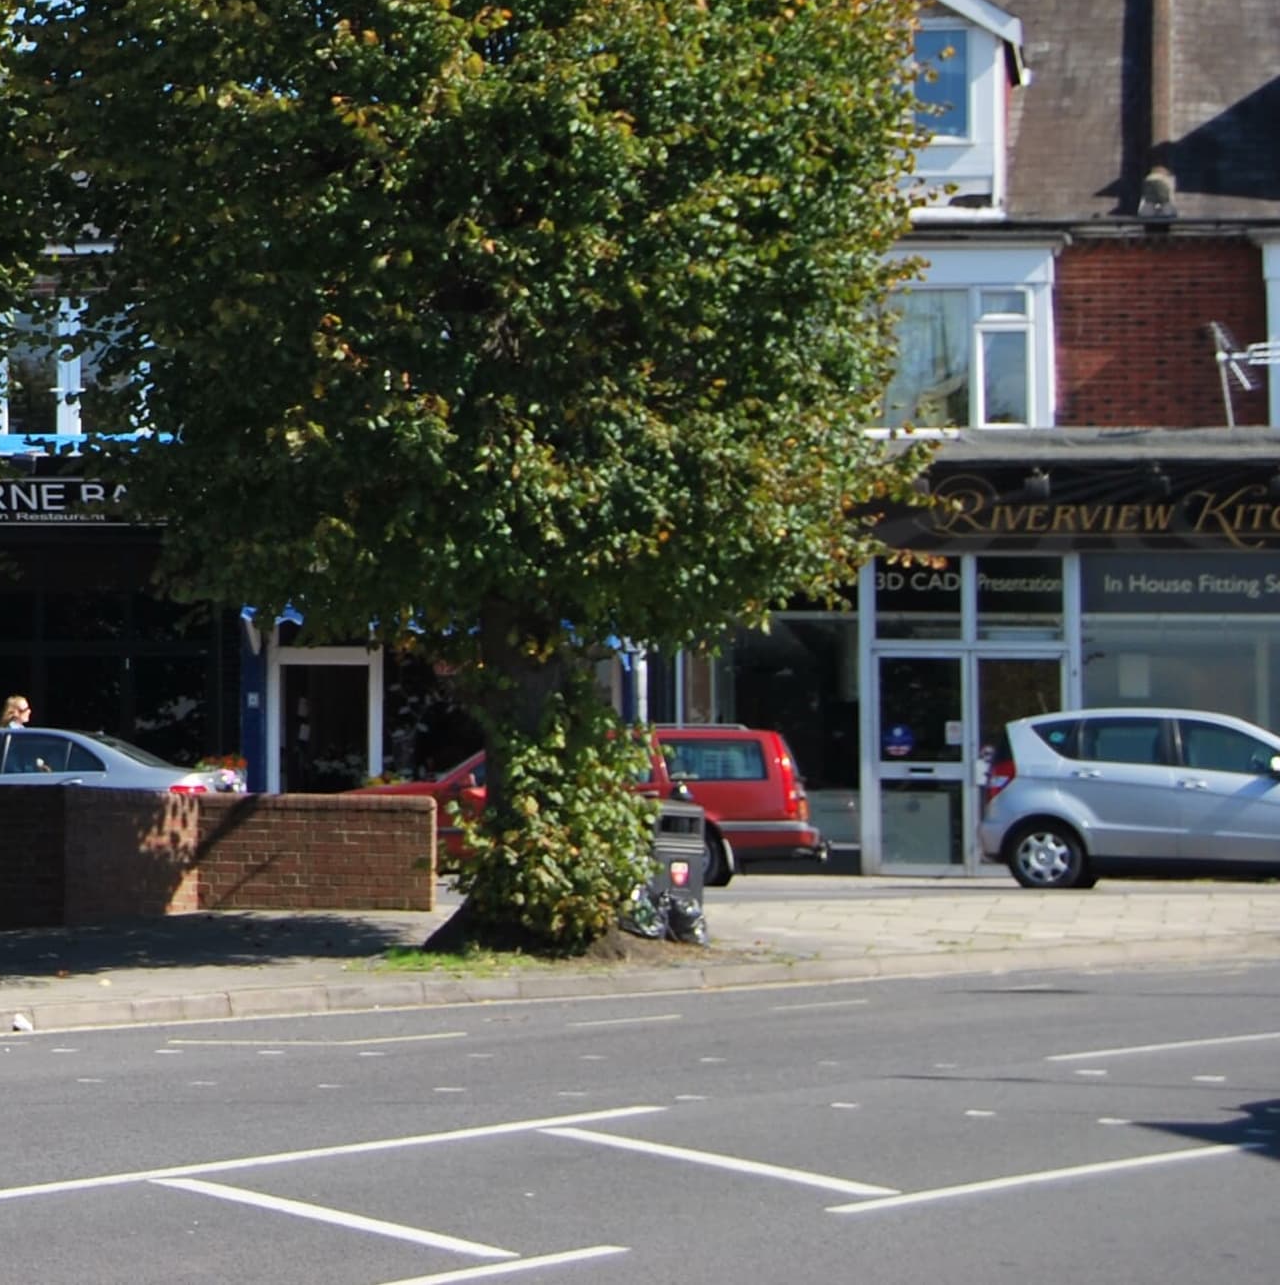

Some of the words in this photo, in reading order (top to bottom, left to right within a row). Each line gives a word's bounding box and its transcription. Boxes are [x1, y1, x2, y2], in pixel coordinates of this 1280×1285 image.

[935, 489, 1177, 532] RIVERVIEW
[876, 571, 904, 591] 3D
[910, 571, 960, 591] CAD
[1104, 574, 1123, 593] In
[1128, 574, 1192, 593] House
[1198, 573, 1260, 599] Fitting
